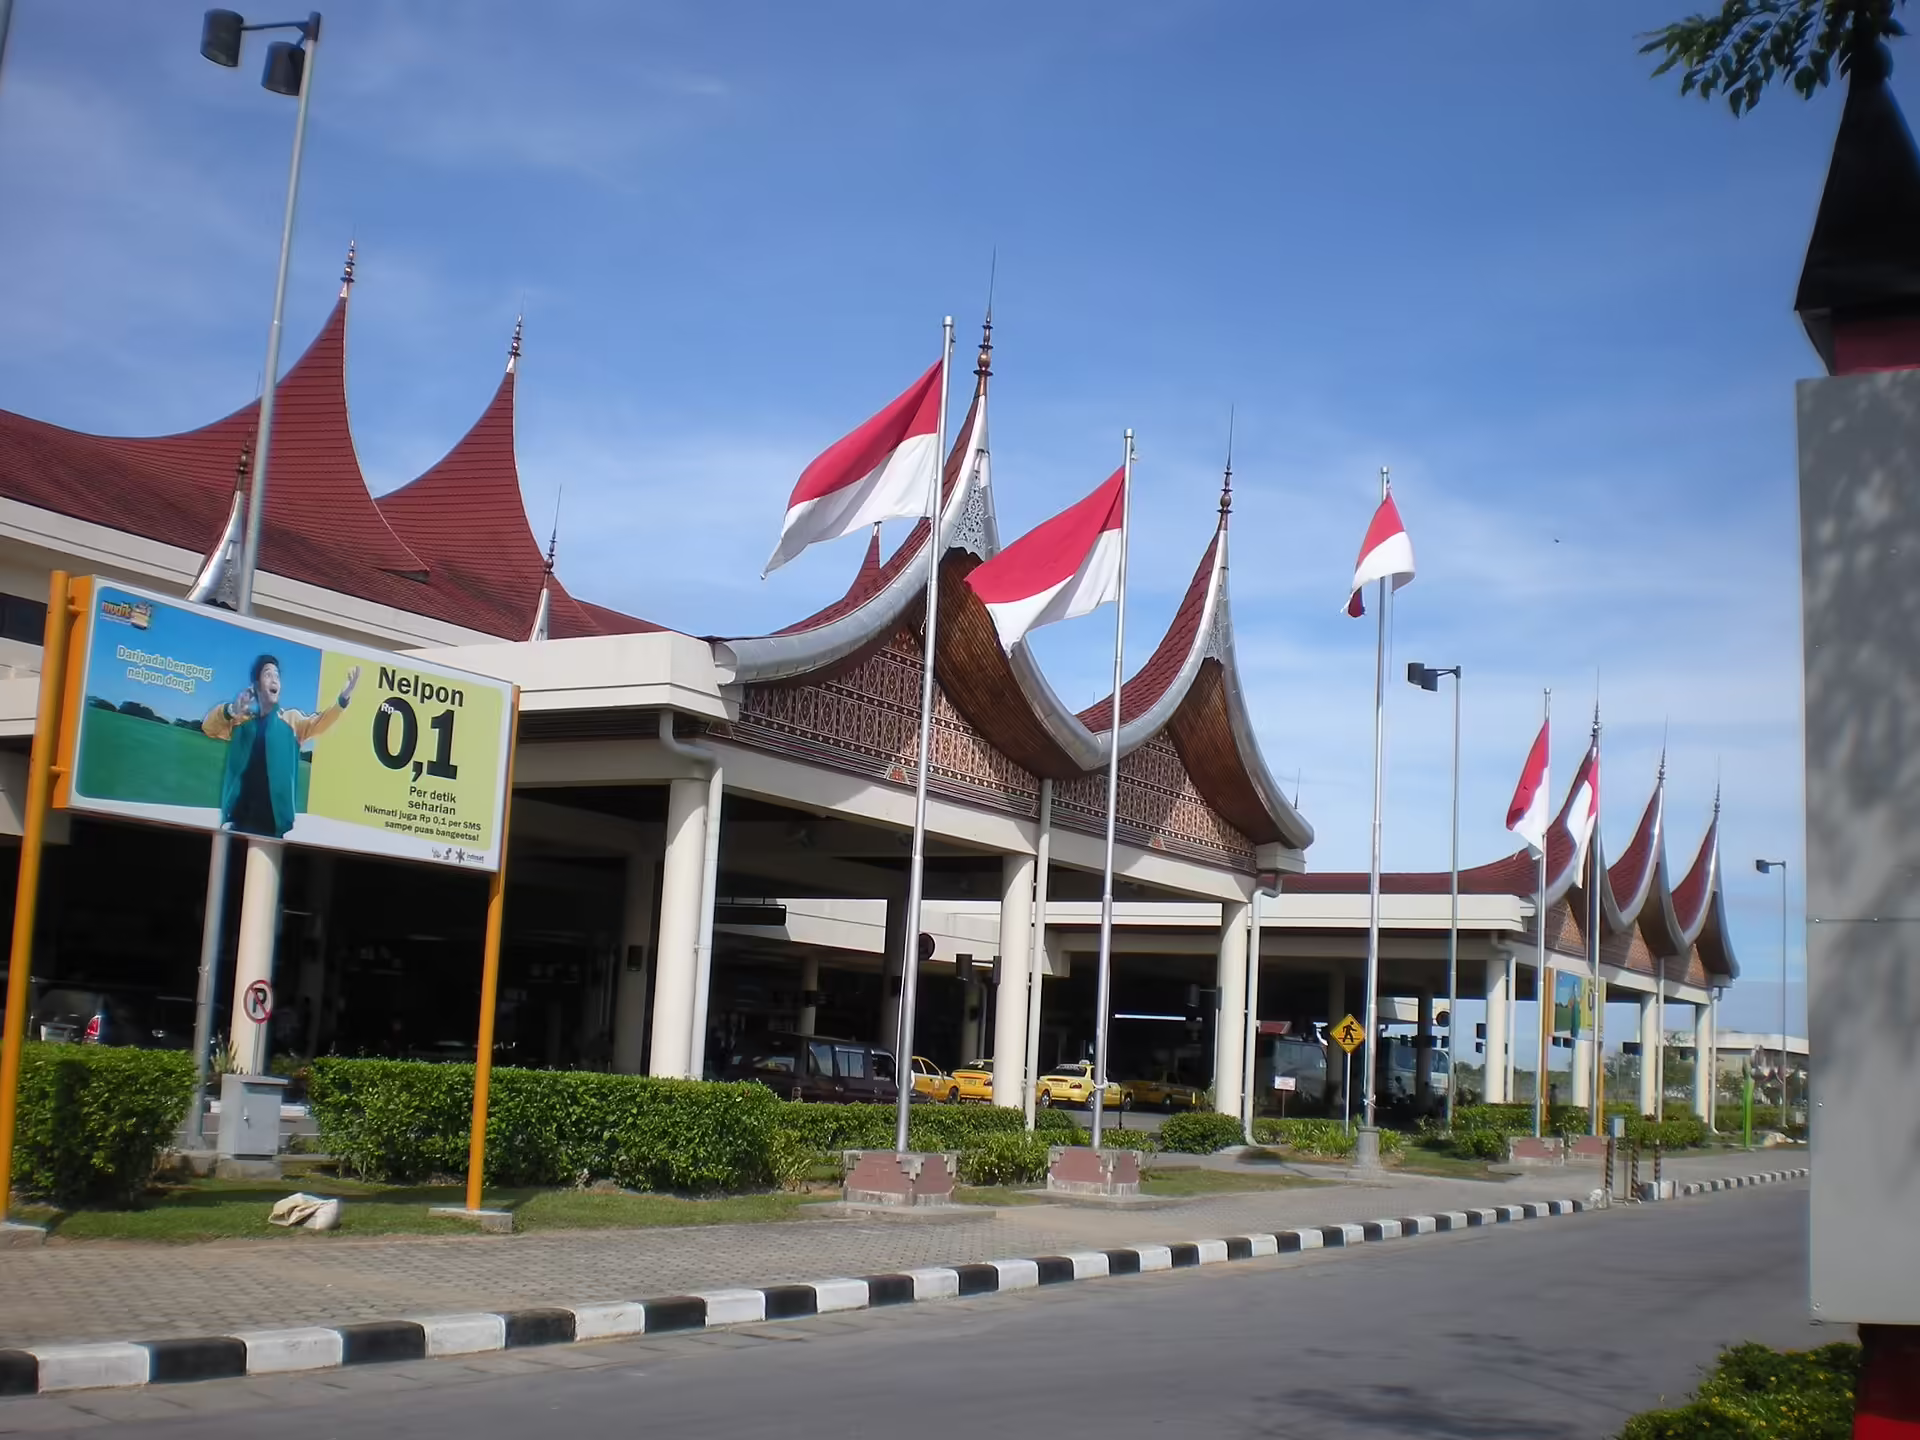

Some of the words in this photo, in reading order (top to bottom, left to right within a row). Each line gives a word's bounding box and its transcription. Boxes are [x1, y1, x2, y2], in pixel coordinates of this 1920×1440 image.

[117, 645, 165, 669] Daripada
[166, 657, 212, 682] bengong
[127, 667, 163, 684] nelpon
[165, 674, 195, 693] dong!
[378, 666, 464, 707] Nelpon
[380, 702, 395, 714] Rp
[372, 696, 458, 782] 0,1
[408, 800, 456, 815] seharian
[409, 786, 428, 799] Per
[430, 790, 457, 804] detik
[363, 804, 398, 818] Nikmati
[398, 811, 417, 821] juga
[419, 813, 431, 824] Rp
[448, 820, 462, 829] per
[463, 821, 482, 831] SMS
[384, 820, 413, 832] sampe
[414, 824, 434, 835] puas
[253, 987, 267, 1013] P
